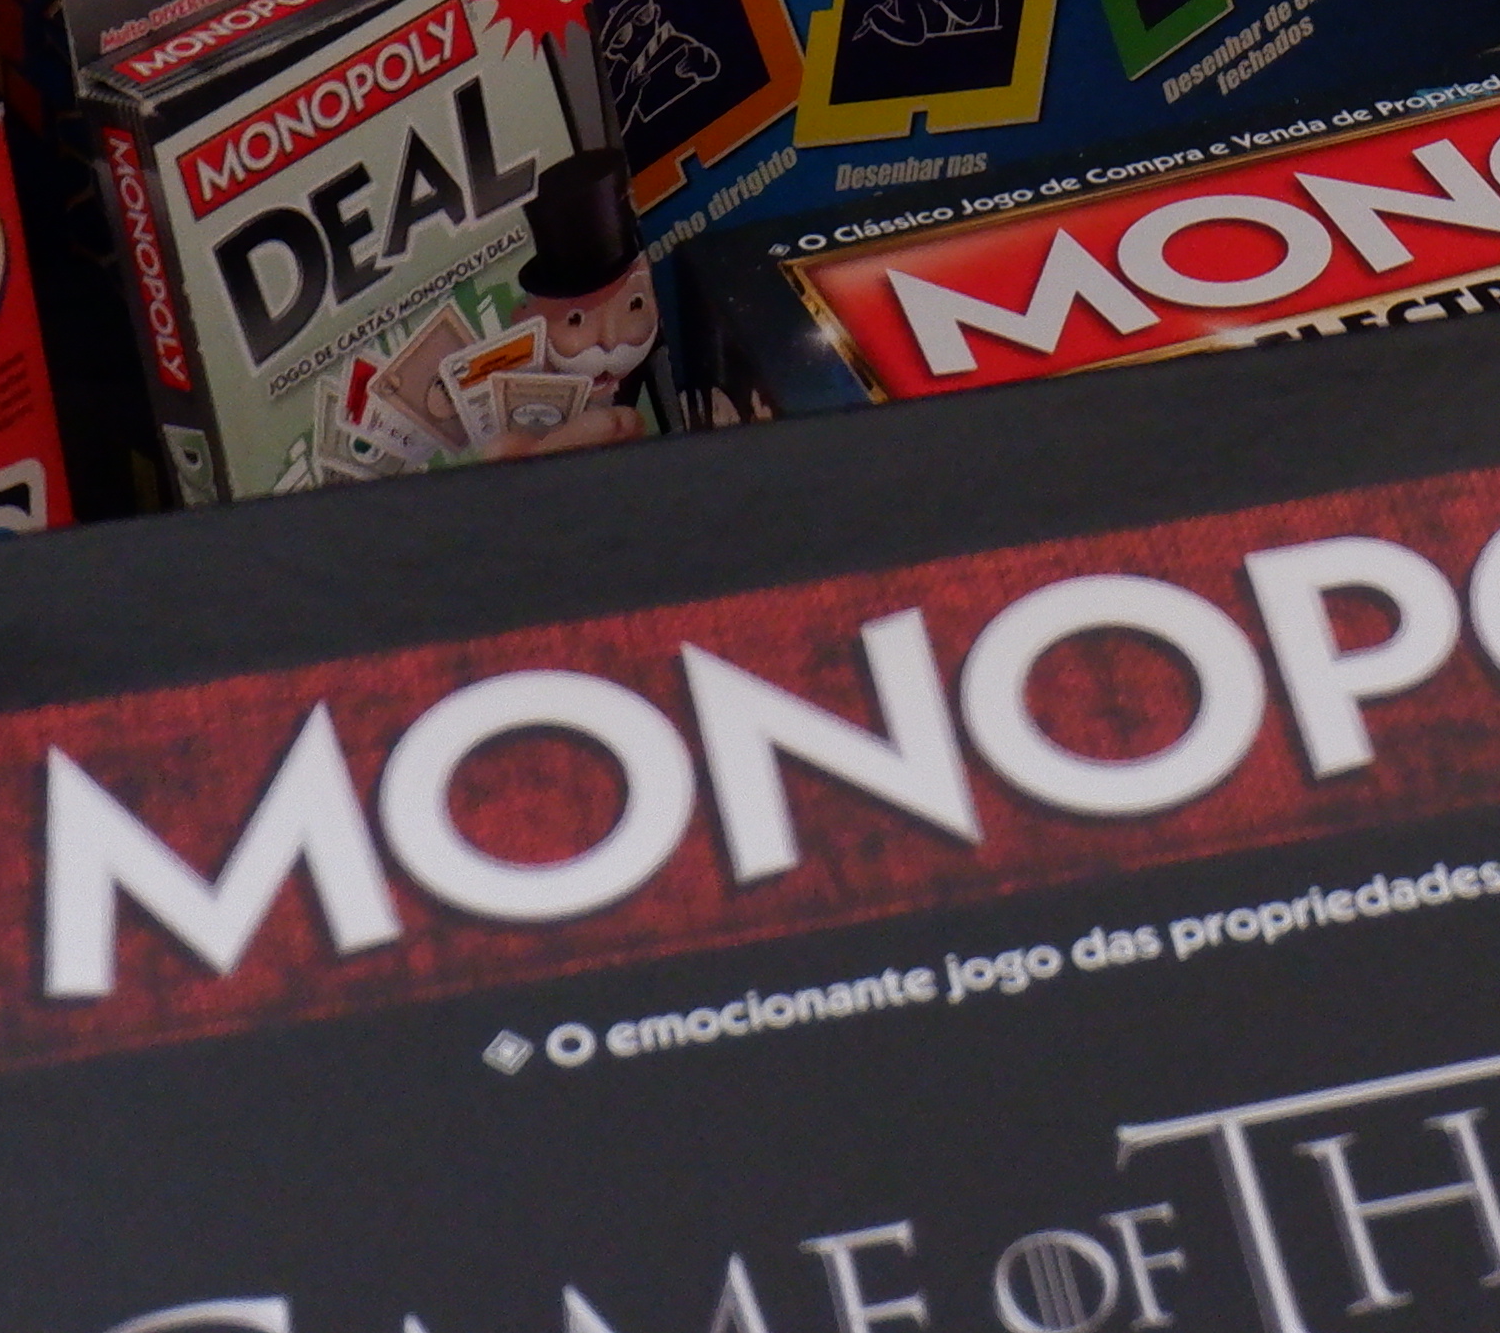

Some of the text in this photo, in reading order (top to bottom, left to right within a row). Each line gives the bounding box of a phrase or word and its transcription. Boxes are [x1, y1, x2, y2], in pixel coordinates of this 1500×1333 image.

[193, 8, 457, 203] MONOPOLY
[1160, 17, 1280, 106] Desenhar
[1214, 15, 1316, 97] fechados
[213, 83, 540, 367] DEAL
[707, 143, 800, 222] dirigido
[797, 232, 826, 253] O
[832, 203, 955, 245] Clássico
[961, 187, 1034, 219] Jogo
[1040, 173, 1082, 198] de
[1085, 145, 1204, 189] Compra
[1207, 142, 1229, 160] e
[1230, 117, 1326, 153] Venda
[1329, 106, 1373, 130] de
[834, 150, 989, 194] Desenhar nas
[108, 133, 188, 385] MONOPOLY
[269, 227, 527, 396] JOGO DE CARTAS MONOPOLY DEAL
[544, 1021, 598, 1070] O
[604, 959, 938, 1060] emocionante
[944, 937, 1064, 1009] jogo
[1069, 917, 1164, 974] das
[991, 1204, 1190, 1333] OF
